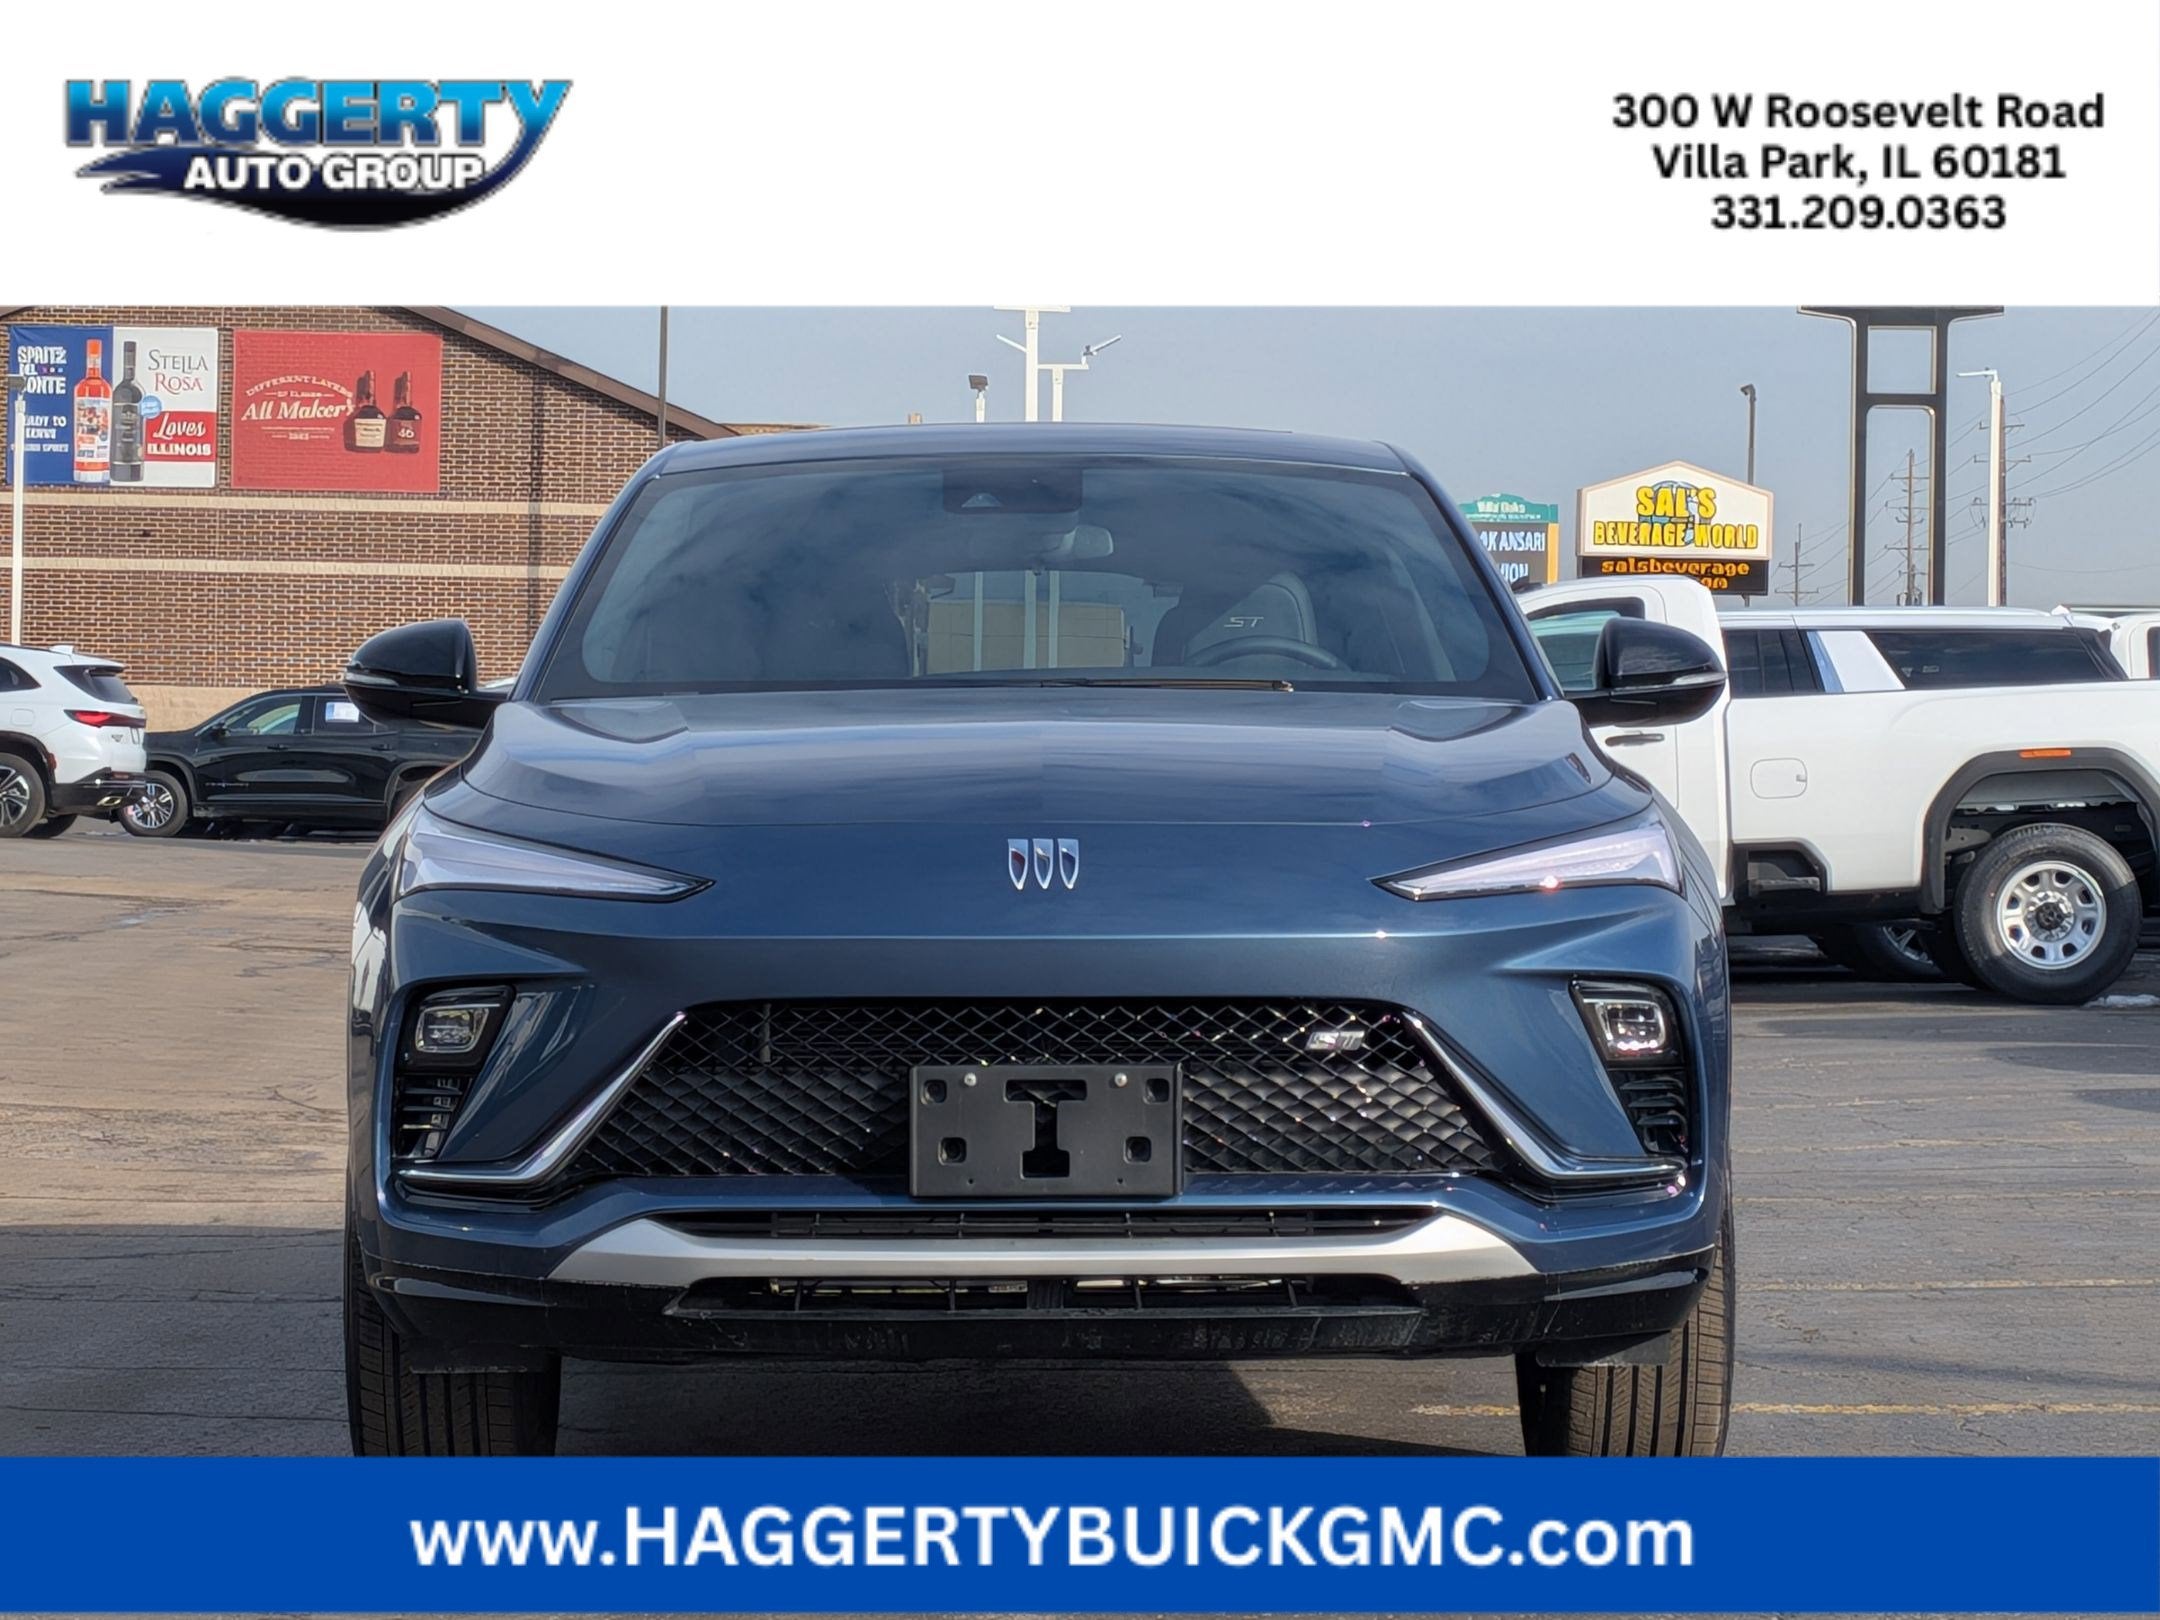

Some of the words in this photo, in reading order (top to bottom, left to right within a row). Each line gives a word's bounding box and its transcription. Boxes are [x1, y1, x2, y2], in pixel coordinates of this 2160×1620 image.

[148, 349, 208, 374] STELLA
[155, 372, 203, 395] ROSA
[241, 401, 275, 421] All
[152, 412, 206, 440] Loves
[147, 443, 211, 456] ILLINOIS
[1636, 486, 1717, 518] SAL'S
[1499, 531, 1545, 551] ANSARI
[1593, 521, 1690, 546] BEVERAGE
[1694, 523, 1759, 549] WORLD
[1602, 556, 1750, 575] salsbeverage
[1224, 616, 1264, 628] ST
